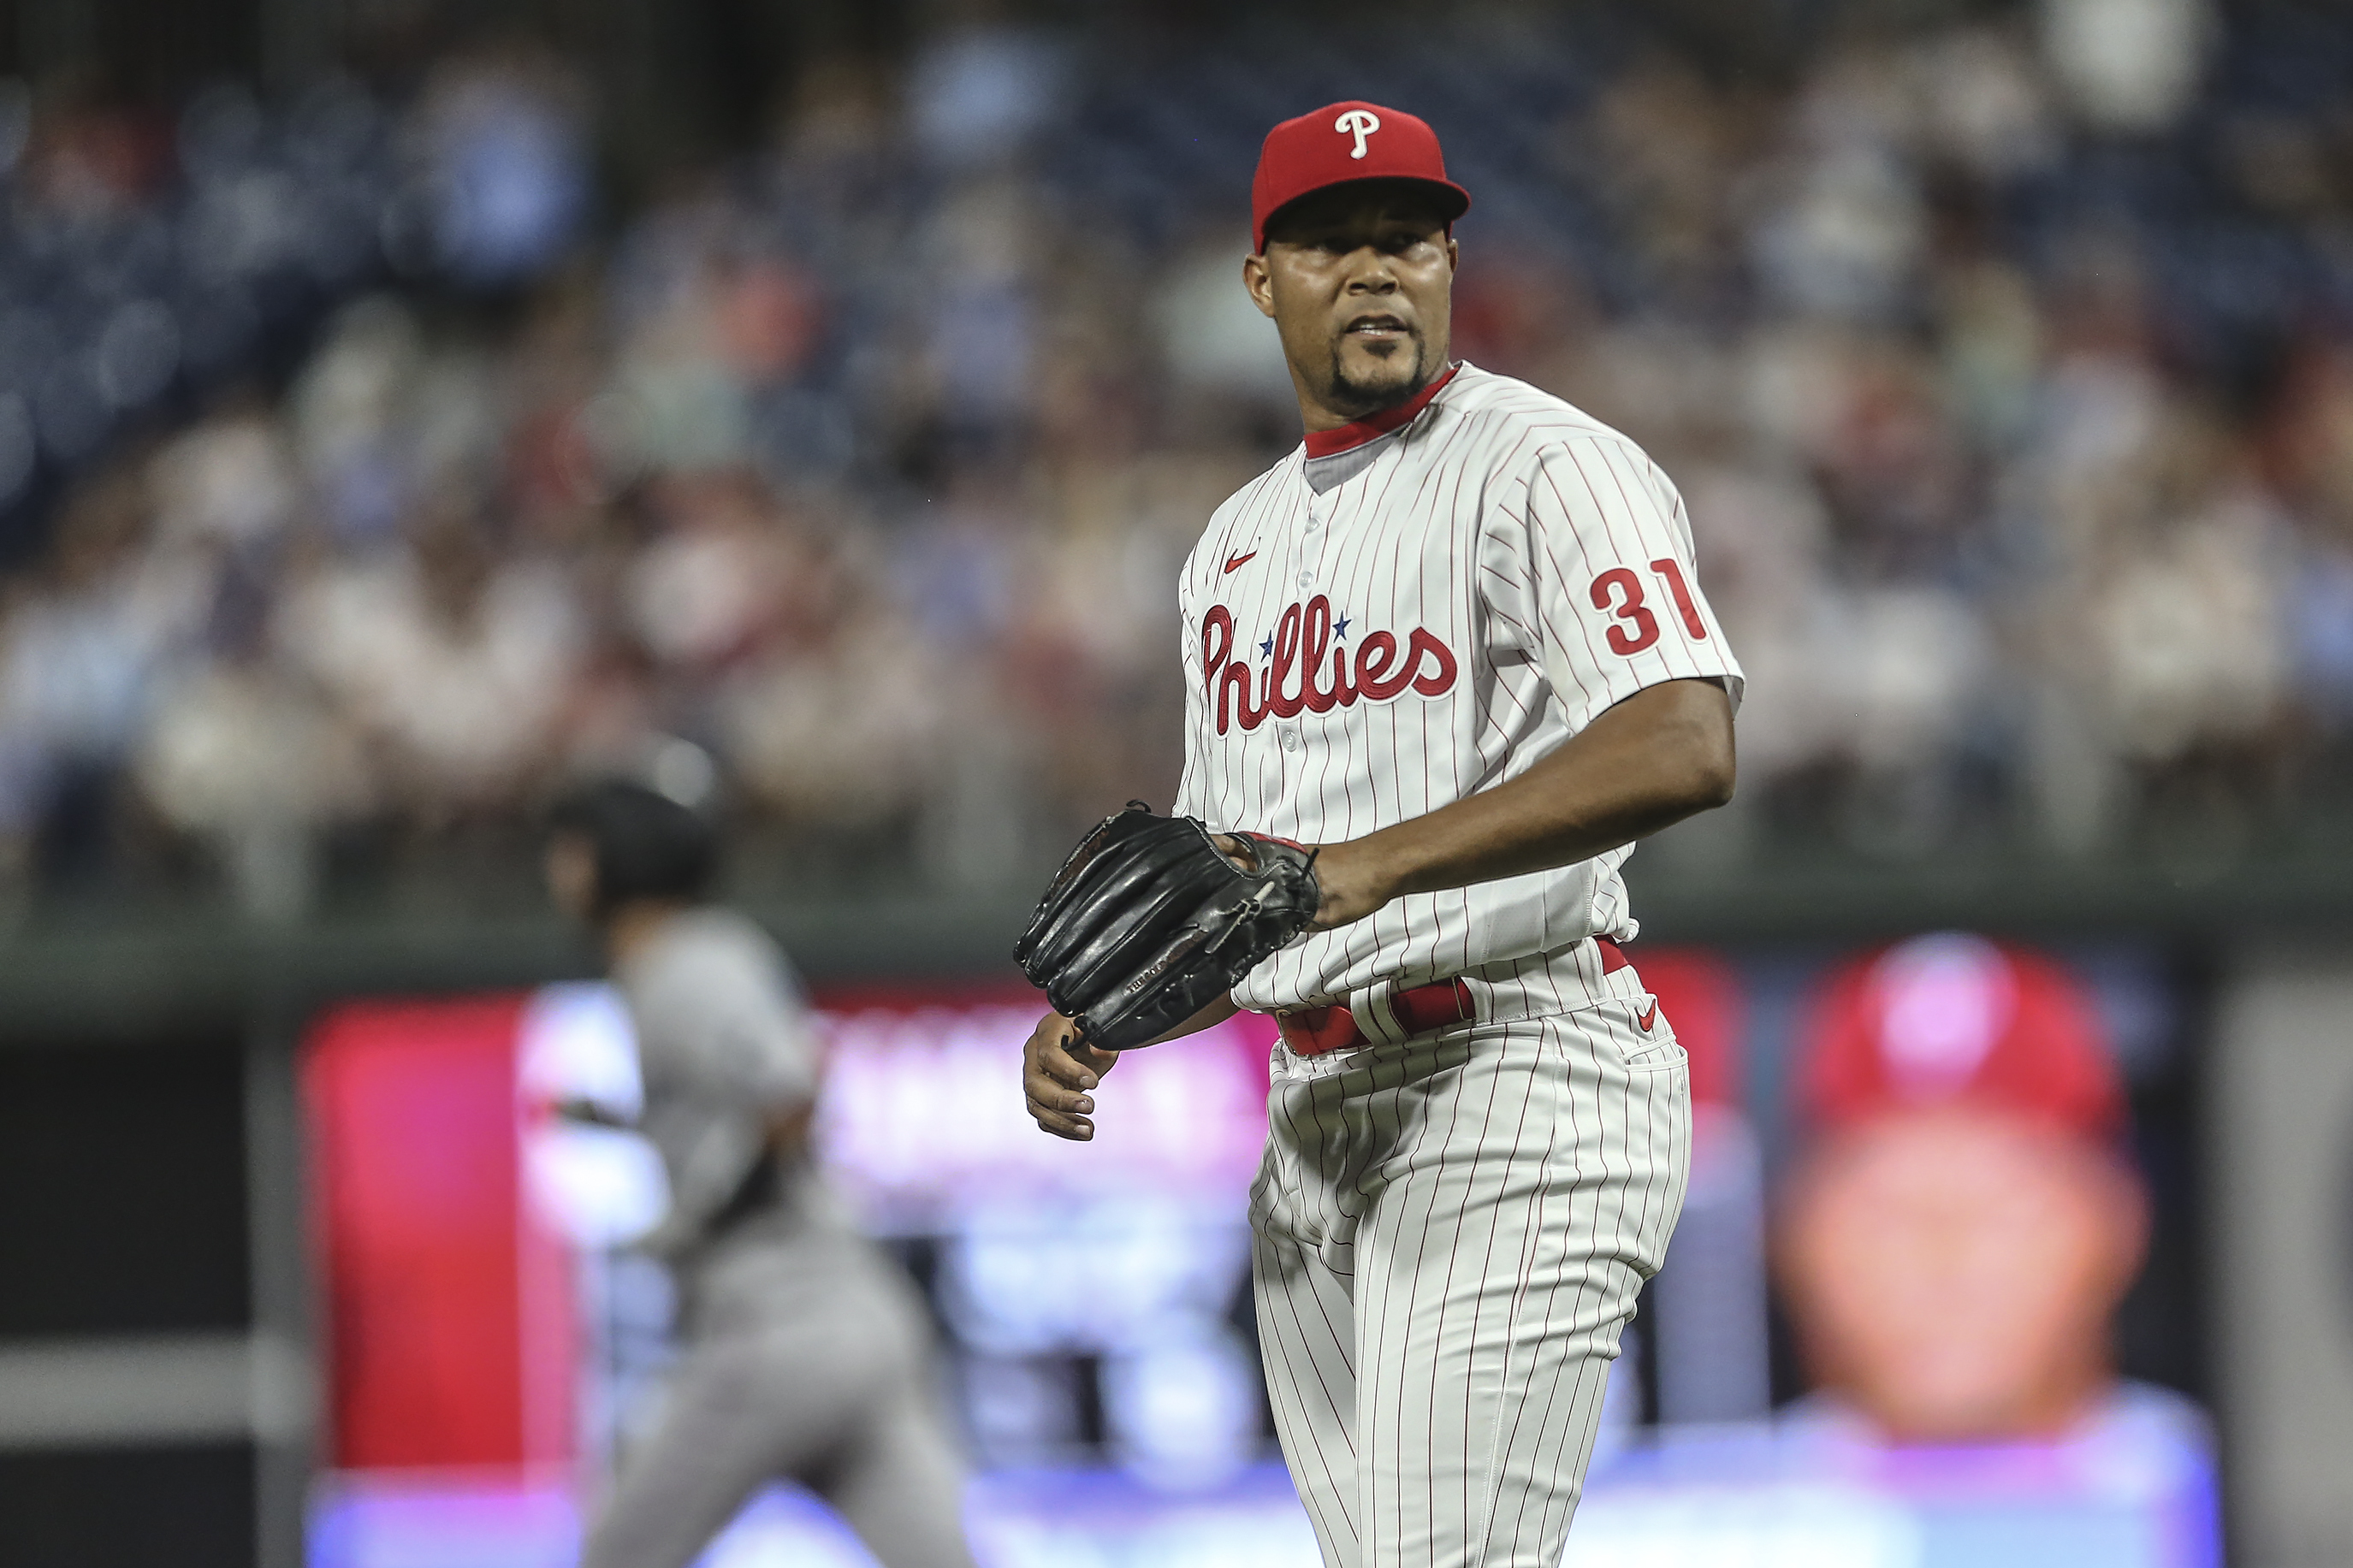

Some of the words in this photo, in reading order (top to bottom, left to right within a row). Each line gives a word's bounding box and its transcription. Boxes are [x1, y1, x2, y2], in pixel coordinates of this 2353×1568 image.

[1334, 109, 1381, 160] P
[1590, 558, 1707, 657] 31
[1200, 593, 1459, 738] Phillies
